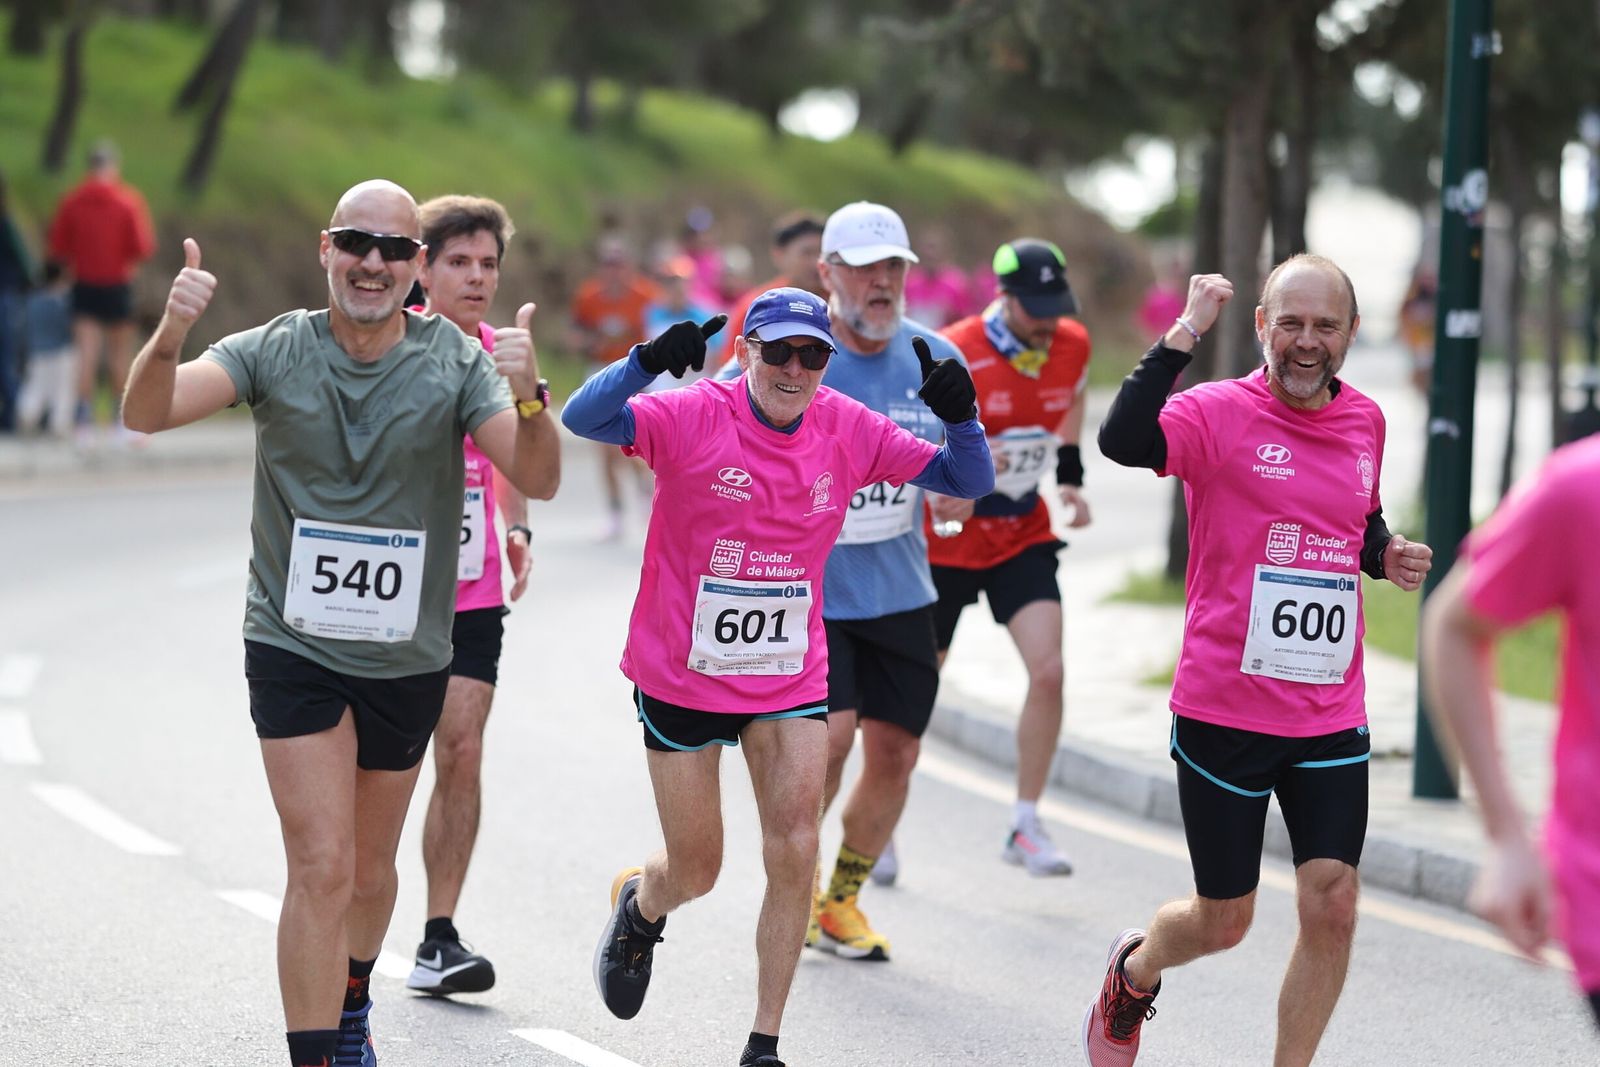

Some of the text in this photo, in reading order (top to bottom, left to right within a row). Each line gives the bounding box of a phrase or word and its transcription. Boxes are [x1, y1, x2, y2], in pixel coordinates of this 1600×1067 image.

[1252, 464, 1296, 477] HYUNDAI
[710, 483, 752, 502] HYUNDAI
[1305, 533, 1348, 550] Ciudad
[749, 550, 792, 564] Ciudad
[1302, 549, 1354, 567] de Málaga
[312, 554, 402, 601] 540
[746, 565, 806, 578] de Málaga
[714, 608, 790, 645] 601
[1272, 599, 1345, 644] 600
